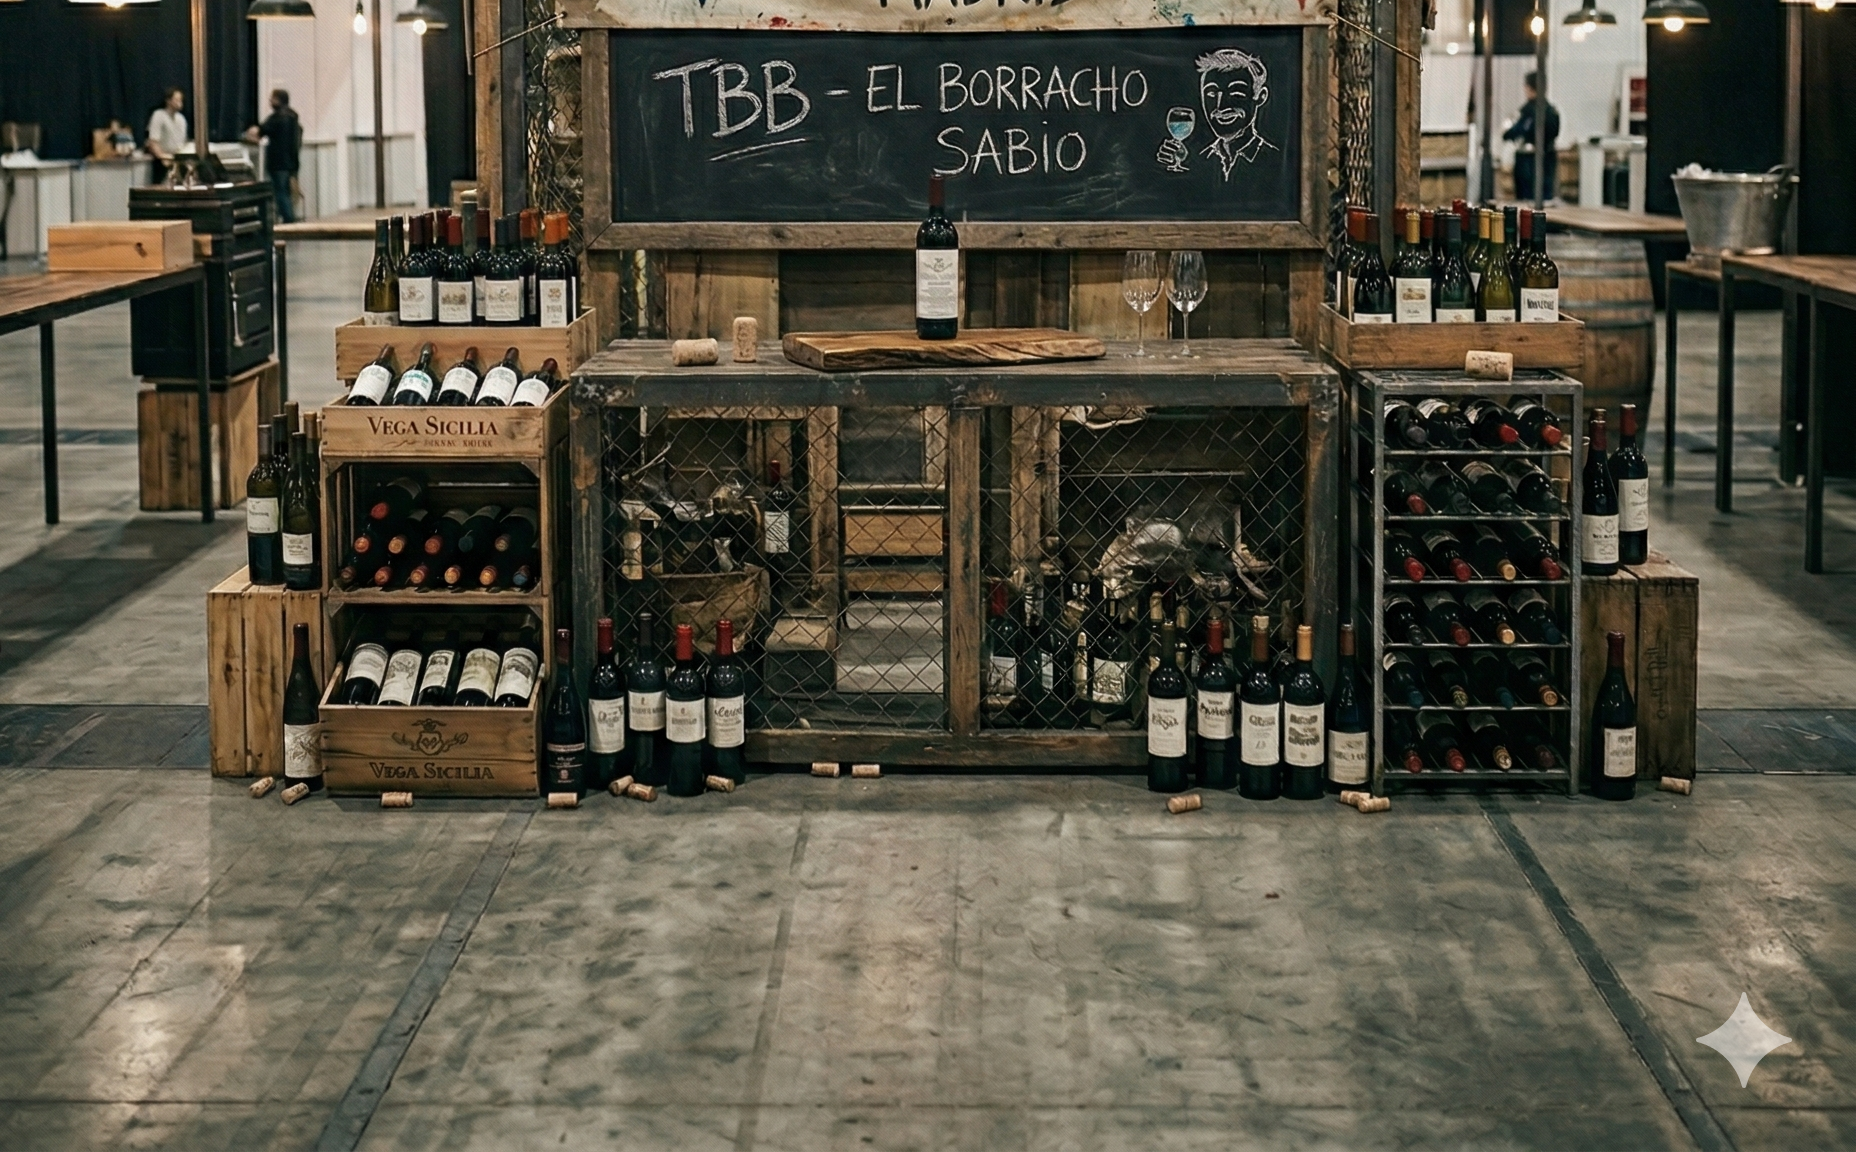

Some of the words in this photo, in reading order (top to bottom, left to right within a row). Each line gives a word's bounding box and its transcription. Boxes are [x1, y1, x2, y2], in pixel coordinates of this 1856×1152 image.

[652, 57, 812, 138] TBB
[866, 64, 921, 113] EL
[938, 62, 1149, 113] BORRACHO
[367, 416, 420, 435] VEGA
[425, 415, 499, 435] SICILIA
[369, 762, 420, 779] VEGA
[424, 762, 494, 779] SICILIA
